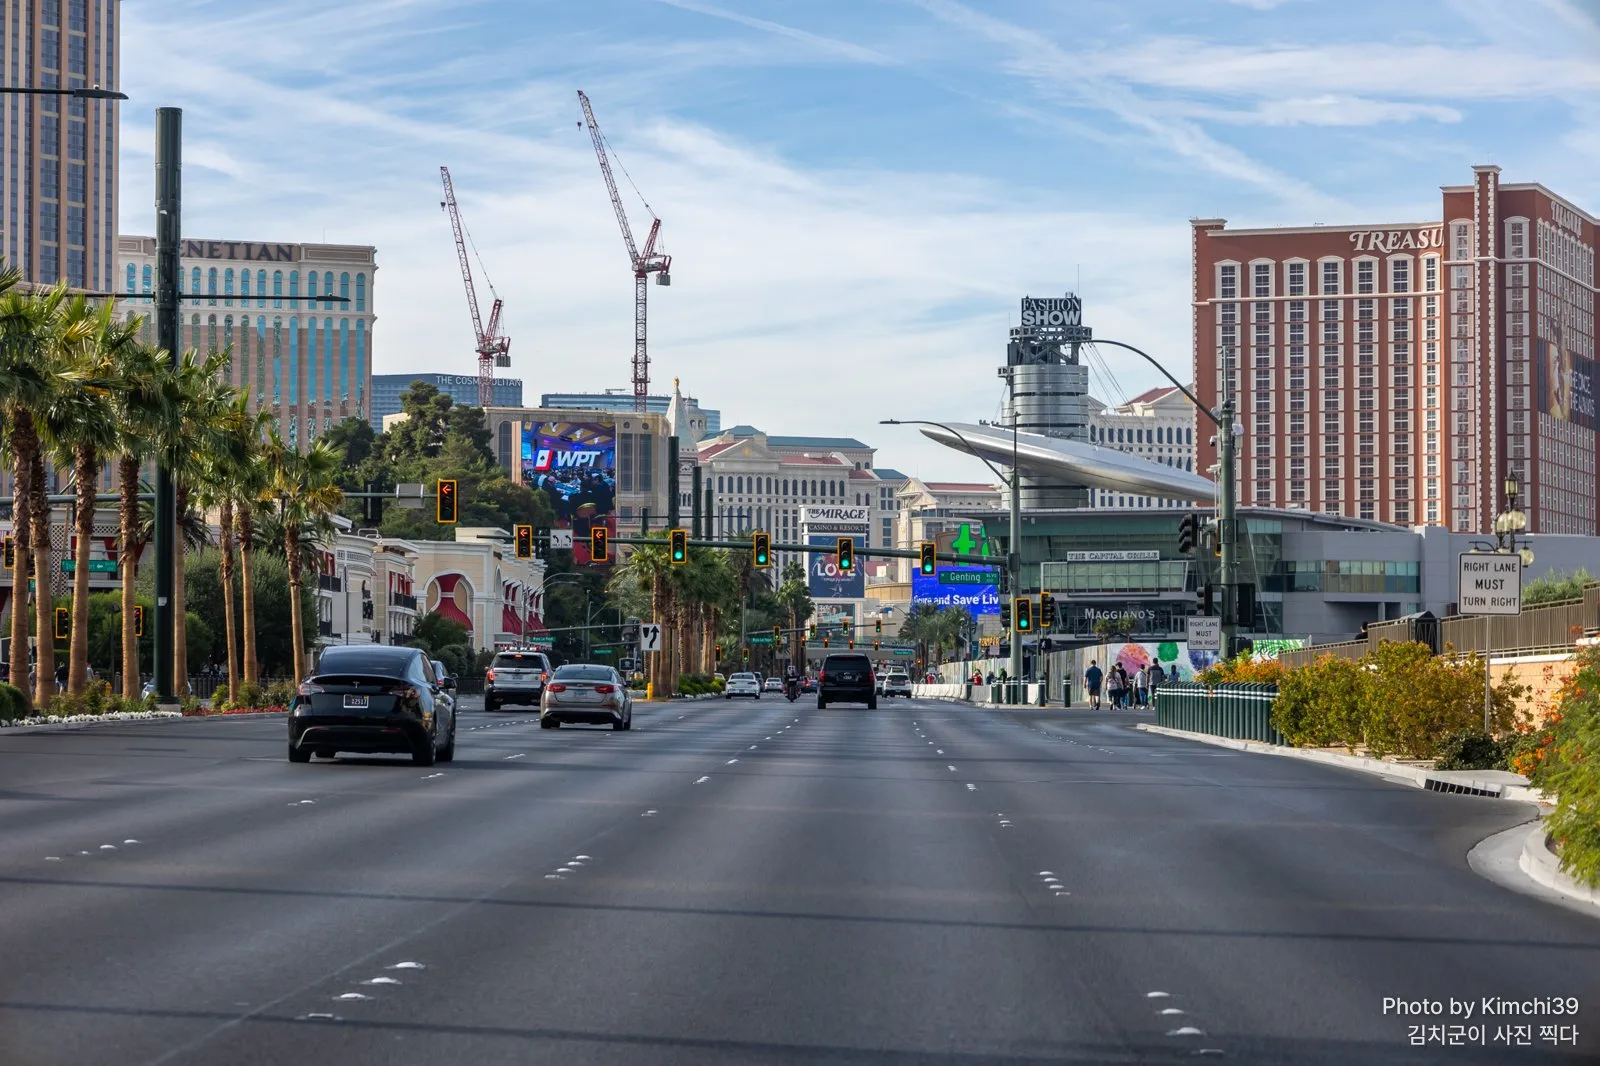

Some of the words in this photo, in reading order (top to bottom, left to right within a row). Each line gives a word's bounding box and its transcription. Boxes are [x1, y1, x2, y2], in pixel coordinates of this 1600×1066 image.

[1023, 299, 1080, 311] FASHION
[1022, 311, 1080, 325] SHOW
[436, 375, 453, 385] THE
[455, 376, 521, 387] COSMOLITAN
[557, 451, 601, 467] WPT
[811, 508, 865, 520] MIRAGE
[1068, 552, 1086, 560] THE
[1089, 552, 1125, 560] CAPITAL
[1127, 552, 1158, 560] GRILLE
[1464, 562, 1489, 572] RIGHT
[1494, 562, 1517, 572] LANE
[950, 572, 981, 583] Genting
[1475, 579, 1505, 590] MUST
[953, 594, 980, 605] Save
[1463, 596, 1486, 606] TURN
[1491, 597, 1517, 607] RIGHT
